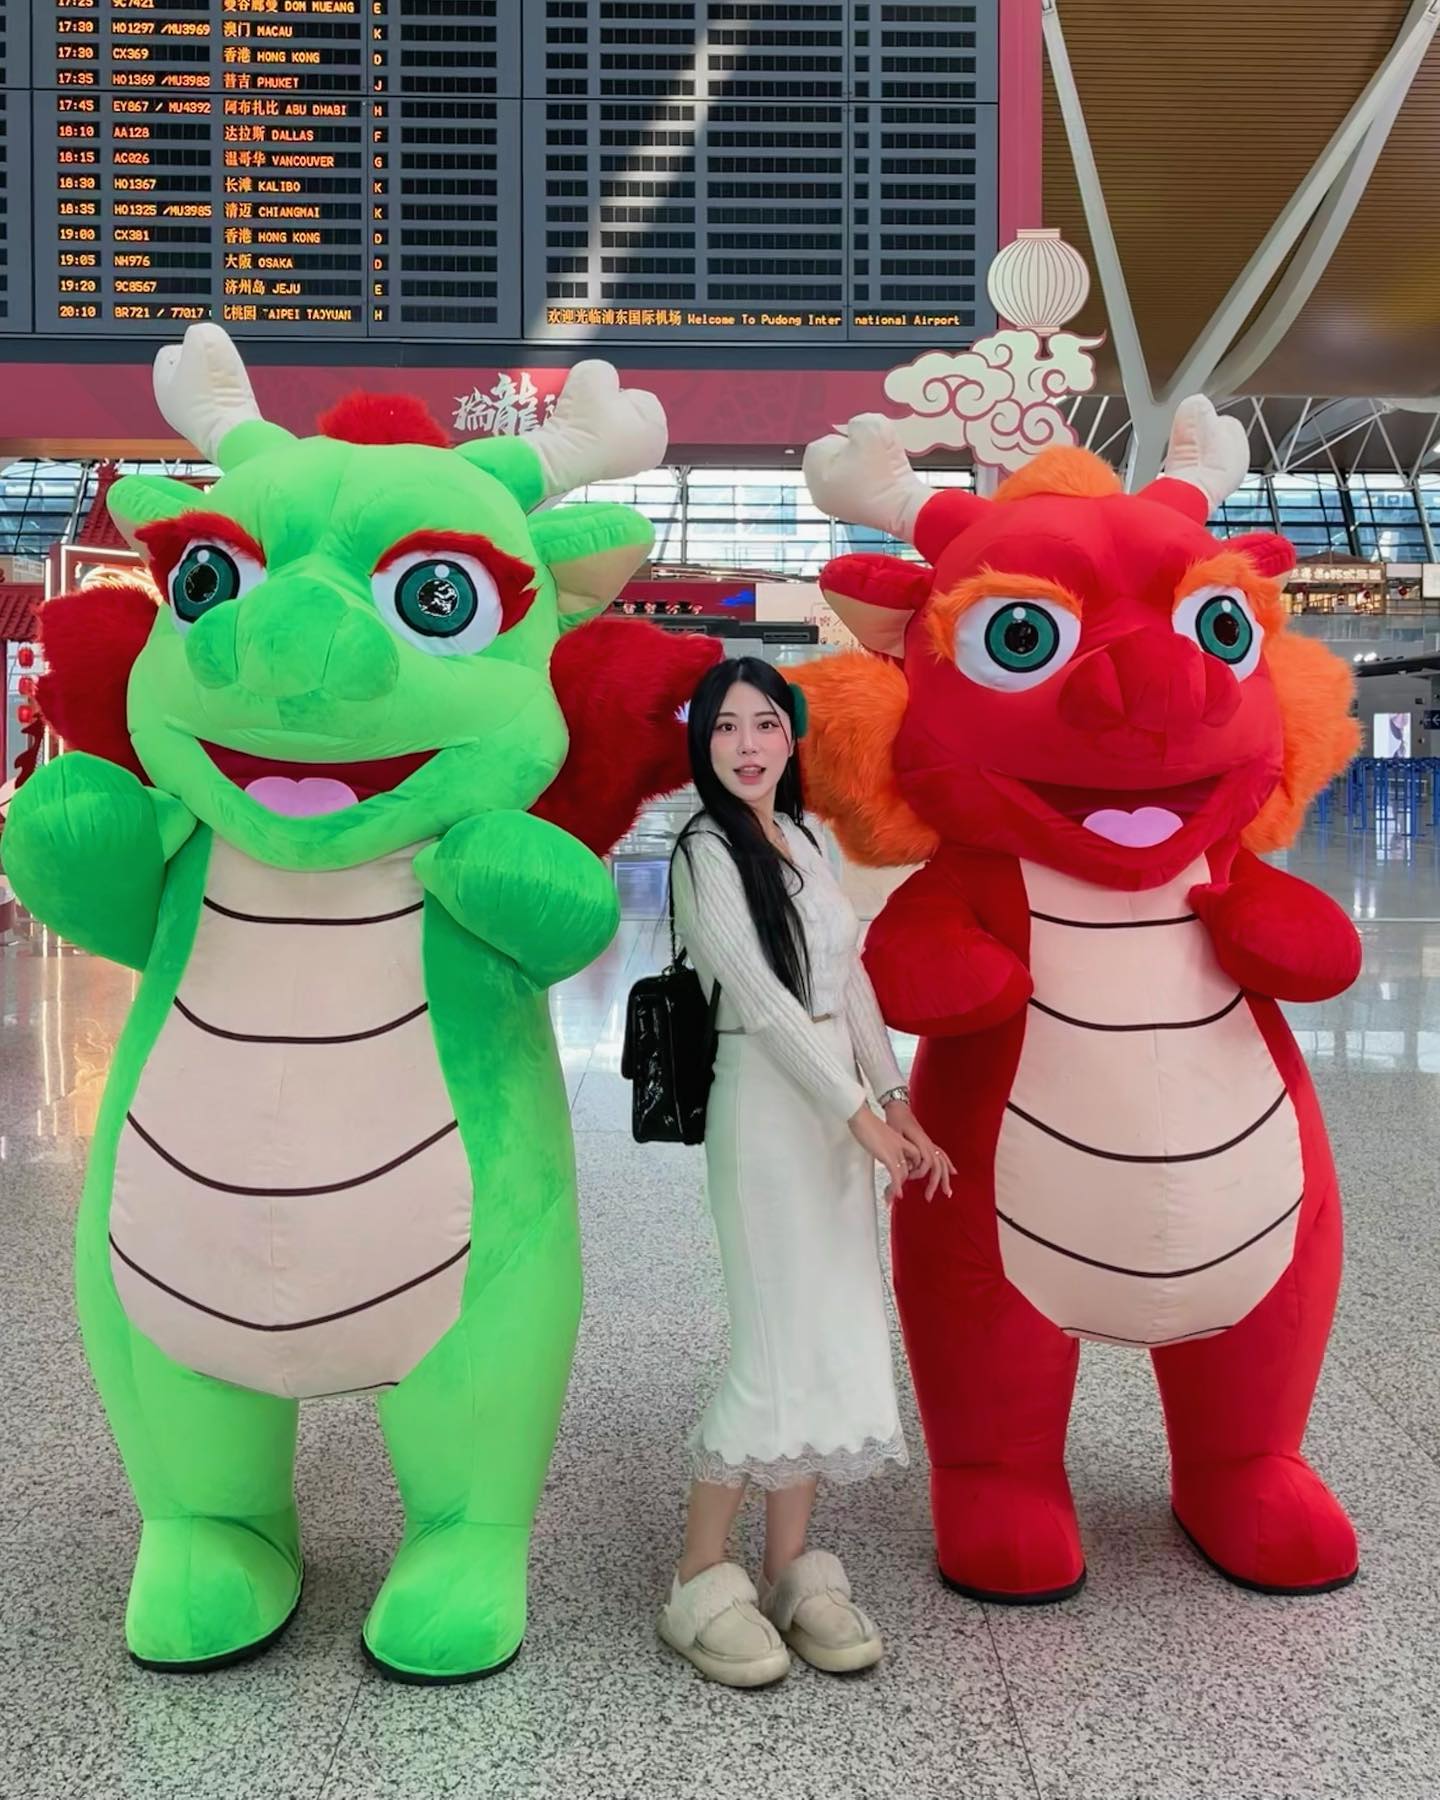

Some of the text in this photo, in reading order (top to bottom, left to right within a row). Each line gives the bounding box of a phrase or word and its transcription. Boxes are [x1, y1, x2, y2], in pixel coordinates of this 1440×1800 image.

[112, 0, 155, 8] 9C7421
[284, 0, 307, 12] DOM
[311, 0, 355, 13] MUEANG
[373, 2, 381, 14] E
[58, 20, 94, 33] 17:30
[112, 22, 155, 34] HO1297
[223, 21, 293, 38] 澳门 MACAU
[373, 28, 381, 39] K
[58, 46, 94, 59] 17:30
[112, 47, 149, 60] CX369
[223, 46, 320, 64] 香港 HONG KONG
[373, 53, 382, 65] D
[59, 72, 94, 85] 17:35
[224, 72, 299, 89] 普吉 PHUKET
[373, 79, 382, 91] J
[59, 99, 94, 111] 17:45
[113, 100, 149, 112] EY867
[168, 101, 211, 114] MU4392
[224, 99, 346, 116] 阿布扎比 ABU DHABI
[374, 105, 383, 117] H
[59, 125, 95, 137] 18:10
[113, 126, 150, 138] AA128
[224, 125, 314, 142] 达拉斯 DALLAS
[374, 130, 382, 142] F
[59, 151, 95, 163] 18:15
[114, 152, 150, 164] AC026
[224, 150, 335, 168] 温哥华 VANCOUVER
[374, 156, 383, 168] G
[59, 177, 96, 189] 18:30
[114, 178, 156, 190] HO1367
[225, 176, 301, 193] 长滩 KALIBO
[374, 181, 382, 193] K
[60, 203, 95, 215] 18:35
[224, 202, 320, 219] 清迈 CHIANGMAI
[374, 207, 382, 219] K
[60, 228, 96, 240] 19:00
[114, 229, 149, 241] CX381
[224, 227, 321, 244] 香港 HONG KONG
[374, 232, 383, 244] D
[60, 254, 96, 266] 19:05
[114, 255, 151, 267] NH976
[225, 253, 293, 270] 大阪 OSAKA
[374, 258, 383, 270] D
[60, 279, 96, 292] 19:20
[114, 280, 157, 293] 9C8567
[224, 278, 301, 296] 济州岛 JEJU
[374, 283, 382, 295] E
[59, 305, 96, 318] 20:10
[374, 309, 383, 321] H
[547, 308, 960, 327] 欢迎光临浦东国际机场 Welcome To Pudong Inter national Airport
